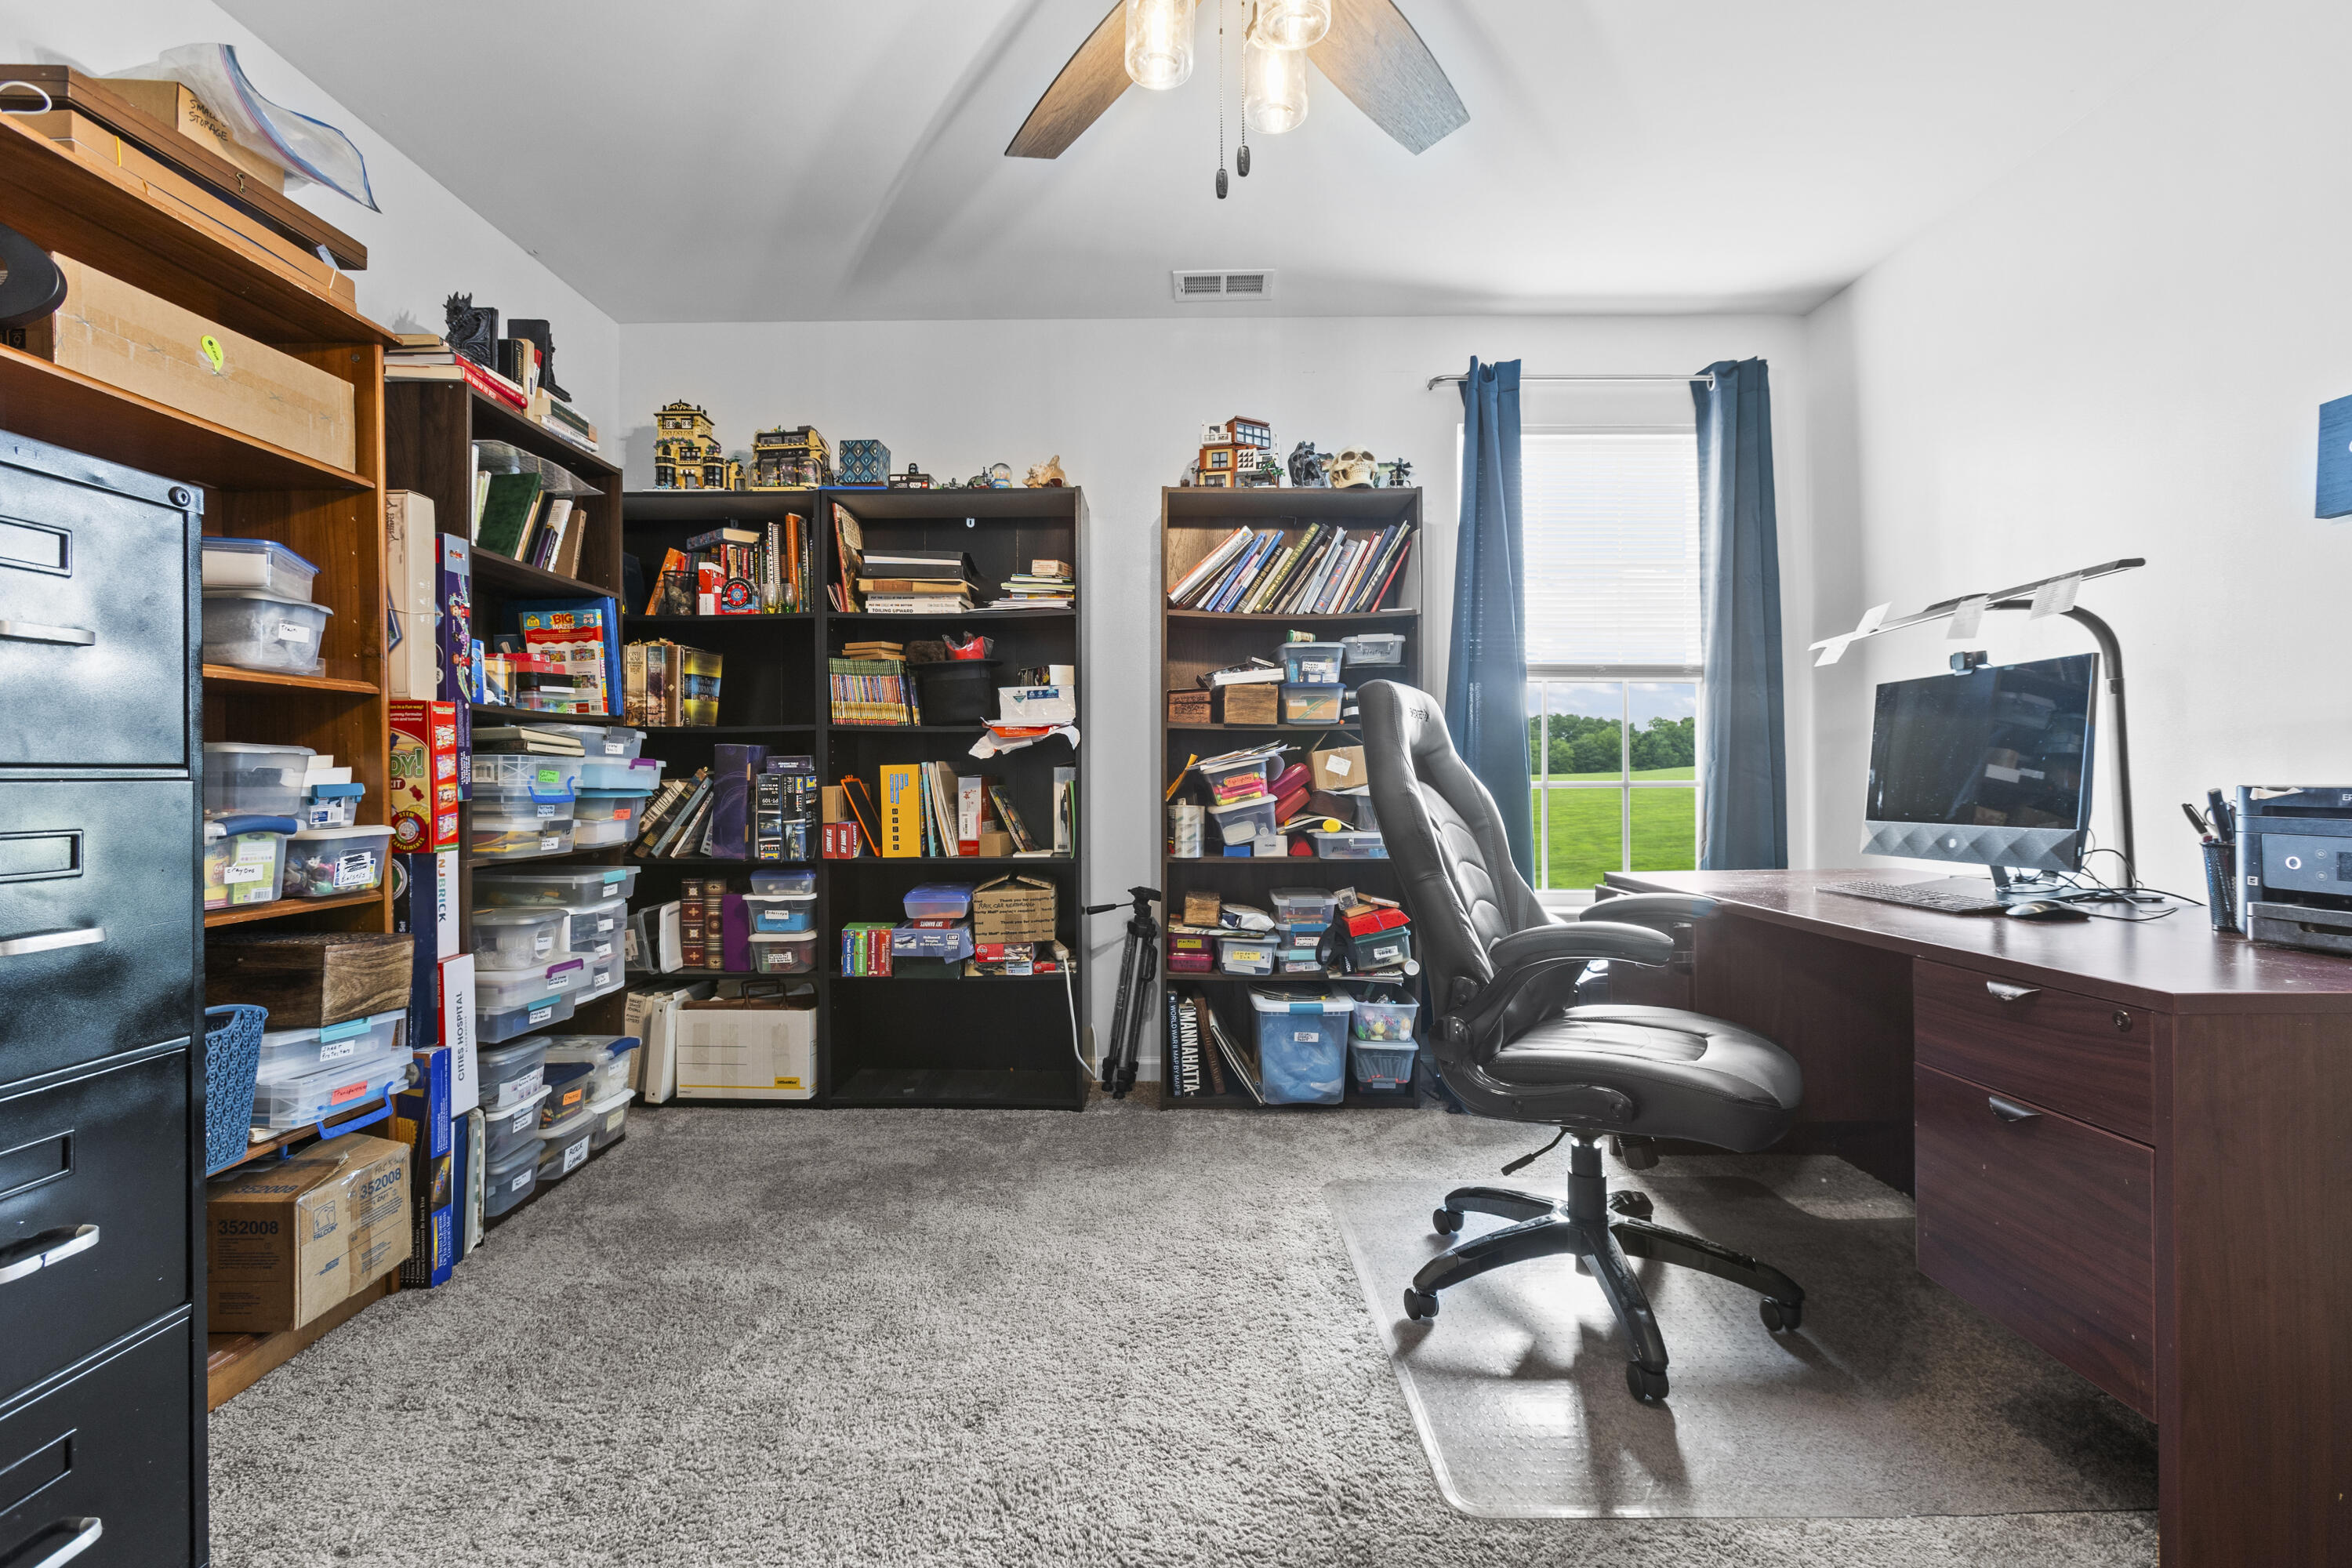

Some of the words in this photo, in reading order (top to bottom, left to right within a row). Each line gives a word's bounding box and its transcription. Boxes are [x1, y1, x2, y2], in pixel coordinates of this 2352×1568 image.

[189, 111, 228, 141] STORAGE
[1290, 532, 1312, 561] BATTLES
[1282, 561, 1292, 576] MAP
[1266, 584, 1276, 597] MAP
[552, 614, 573, 625] BIG
[392, 837, 425, 851] EXPERIMENTS
[437, 851, 446, 922] ENJBRICK
[456, 991, 464, 1044] HOSPITAL
[1180, 1011, 1200, 1093] MANNAHATTA
[1174, 1065, 1179, 1074] BY
[568, 1142, 583, 1156] ROCK
[567, 1153, 583, 1169] GAME
[235, 1185, 299, 1194] 352008
[360, 1167, 402, 1200] 352008
[219, 1220, 279, 1236] 352008
[314, 1225, 336, 1241] FALCON
